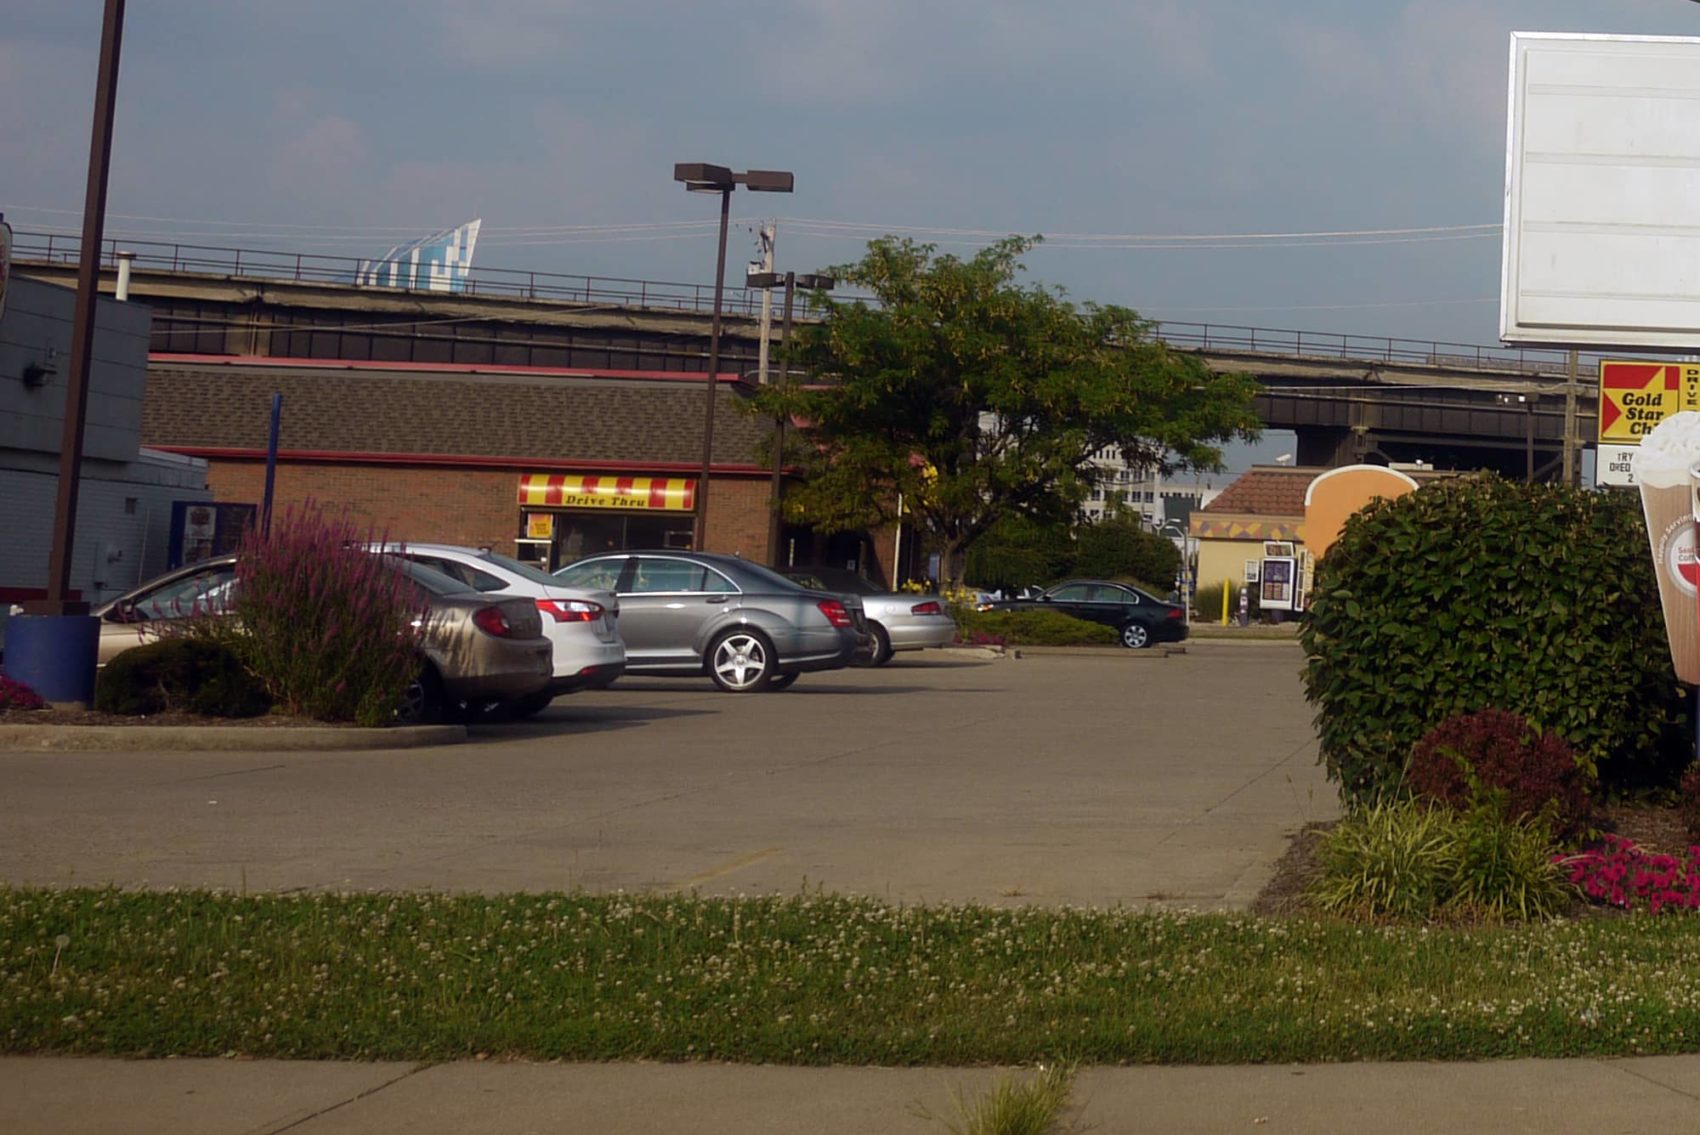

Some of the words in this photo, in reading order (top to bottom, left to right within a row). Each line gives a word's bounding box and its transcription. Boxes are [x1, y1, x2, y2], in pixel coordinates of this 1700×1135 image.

[1622, 392, 1663, 406] Gold
[1626, 407, 1664, 421] Star
[565, 494, 606, 506] Drive
[611, 496, 646, 507] Thru
